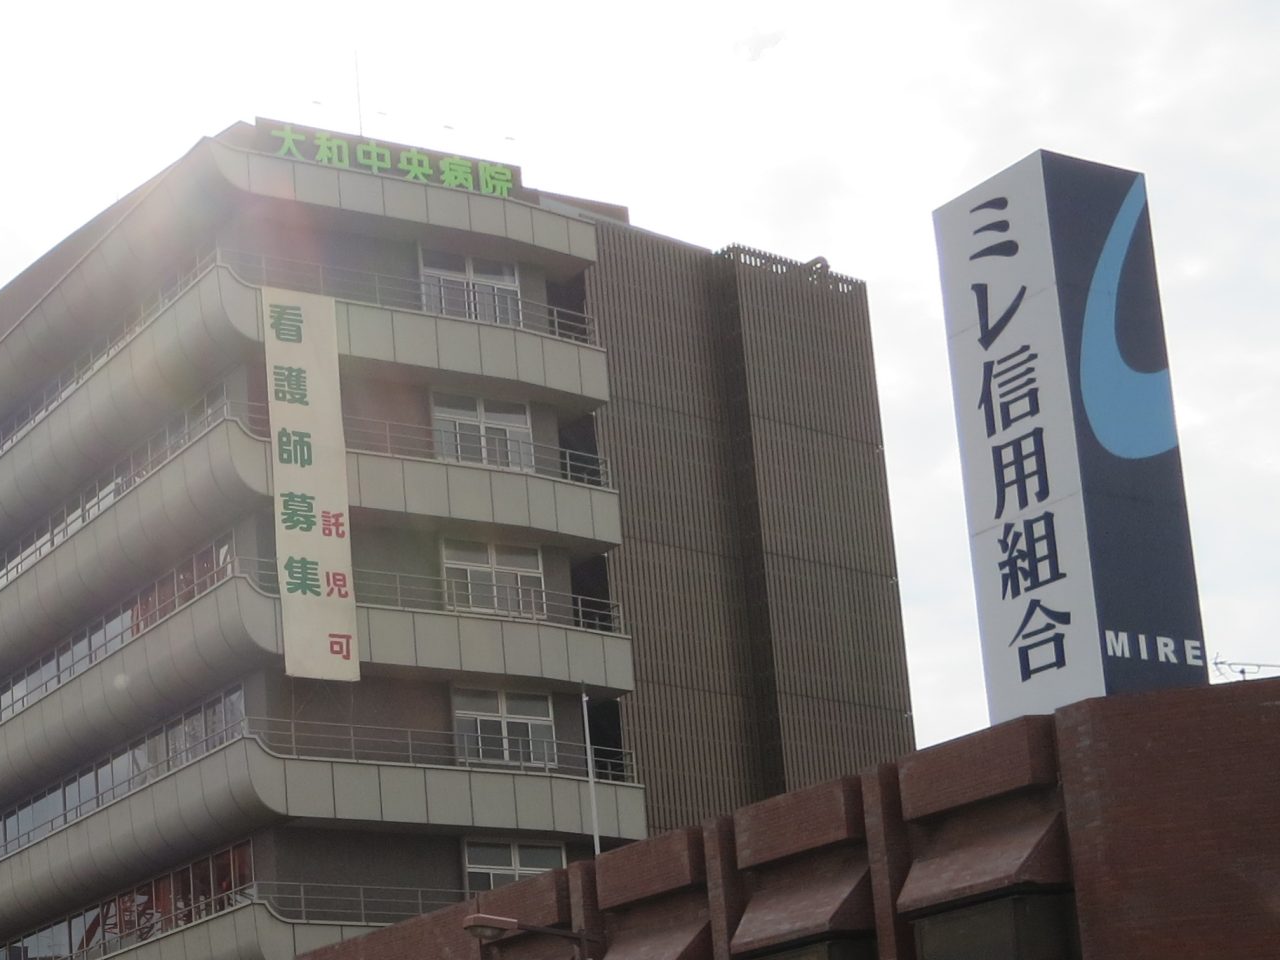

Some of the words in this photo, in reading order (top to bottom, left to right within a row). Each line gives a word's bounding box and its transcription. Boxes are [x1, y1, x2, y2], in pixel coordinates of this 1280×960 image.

[271, 123, 514, 198] 大和中央病院
[269, 303, 322, 597] 看護師募集
[969, 195, 1072, 683] ミレ信用組合
[319, 510, 354, 662] 託児可
[1105, 628, 1204, 667] MIRE
